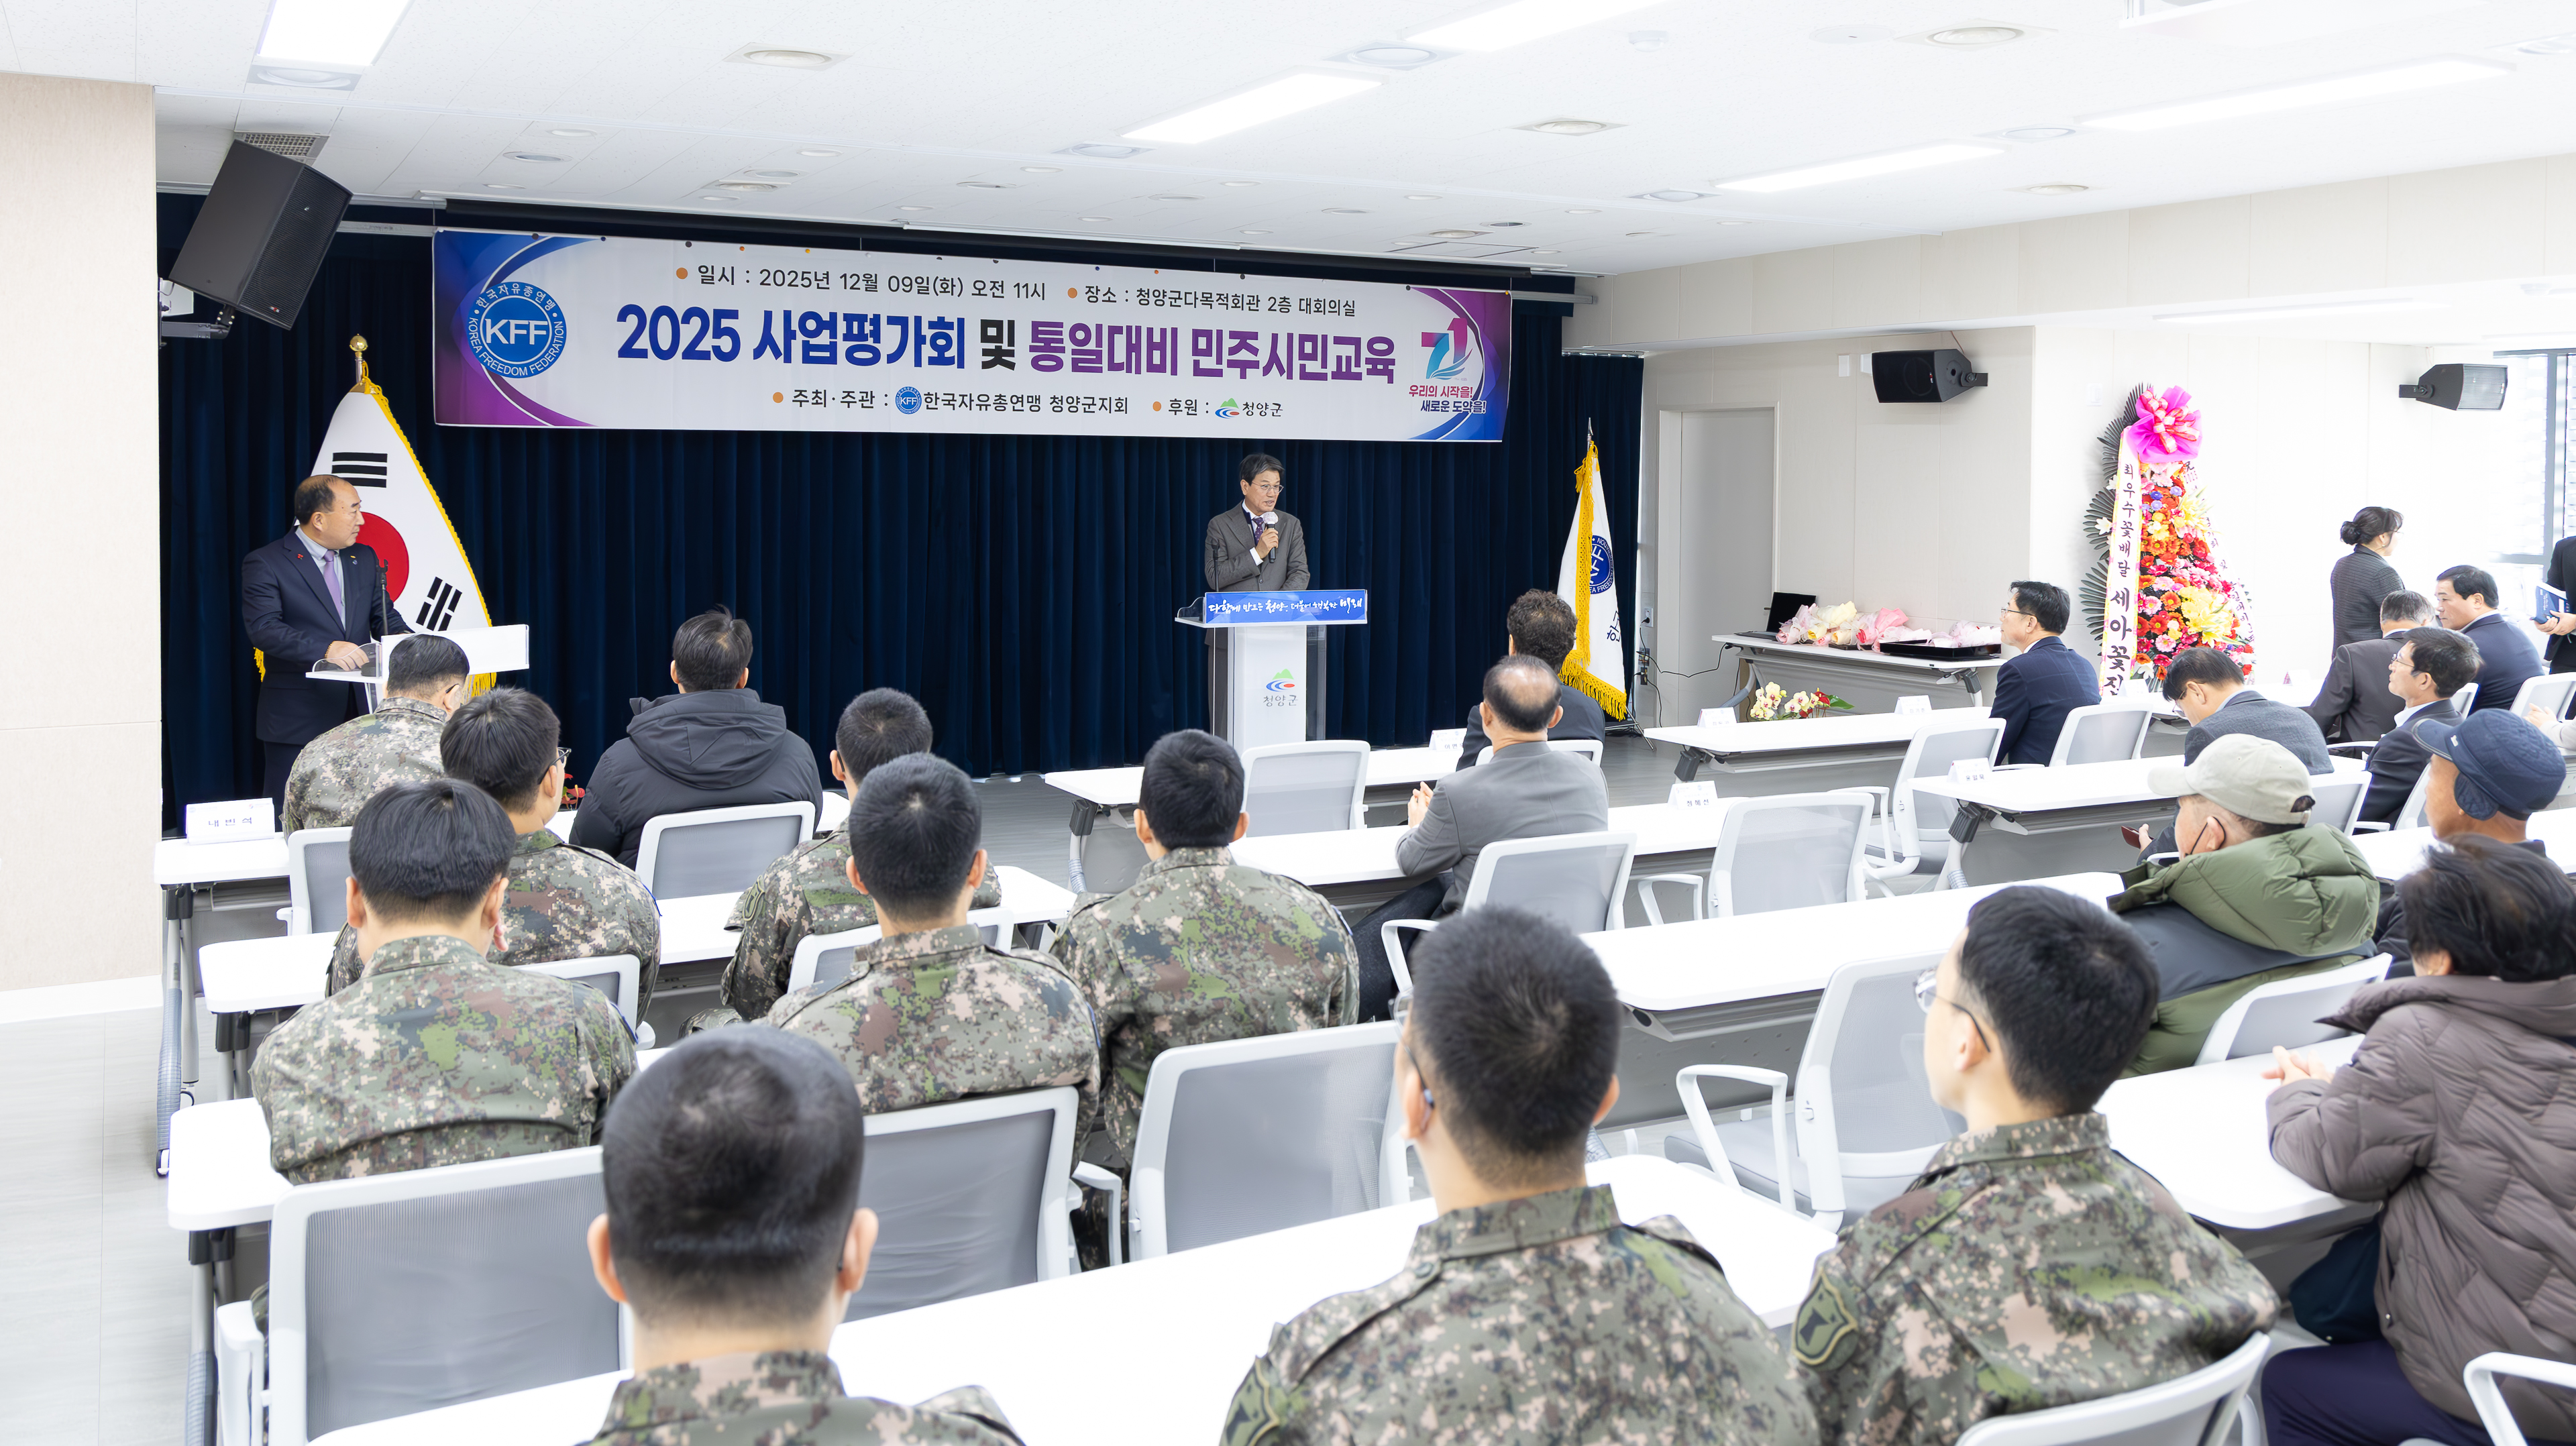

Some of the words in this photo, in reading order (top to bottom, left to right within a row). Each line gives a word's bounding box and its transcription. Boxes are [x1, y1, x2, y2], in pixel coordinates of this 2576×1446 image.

[698, 265, 735, 286] 일시
[759, 268, 830, 290] 2025년
[839, 273, 878, 292] 12월
[888, 276, 963, 298] 09일(화)
[971, 280, 1005, 298] 오전
[1013, 282, 1045, 300] 11시
[476, 283, 556, 311] 한국자유총연맹
[1085, 285, 1118, 303] 장소
[1136, 288, 1260, 312] 청양군다목적회관
[1267, 296, 1292, 314] 2층
[1299, 297, 1356, 317] 대회의실
[484, 318, 548, 345] KFF
[468, 317, 483, 353] KOREA
[478, 351, 529, 376] FREEDOM
[529, 321, 564, 374] FEDERATION
[616, 304, 741, 362] 2025
[753, 309, 965, 369] 사업평가회
[980, 319, 1016, 371] 및
[1028, 321, 1178, 376] 통일대비
[1191, 328, 1396, 384] 민주시민교육
[900, 396, 918, 406] KFF
[1408, 384, 1438, 398] 우리의
[1440, 386, 1473, 398] 시작을!
[923, 392, 1041, 412] 한국자유총연맹
[1049, 394, 1128, 414] 청양군지회
[1168, 398, 1198, 416] 후원
[1242, 402, 1284, 417] 청양군
[1420, 400, 1450, 412] 새로운
[1452, 400, 1487, 414] 도약을!
[1263, 695, 1298, 707] 청양군
